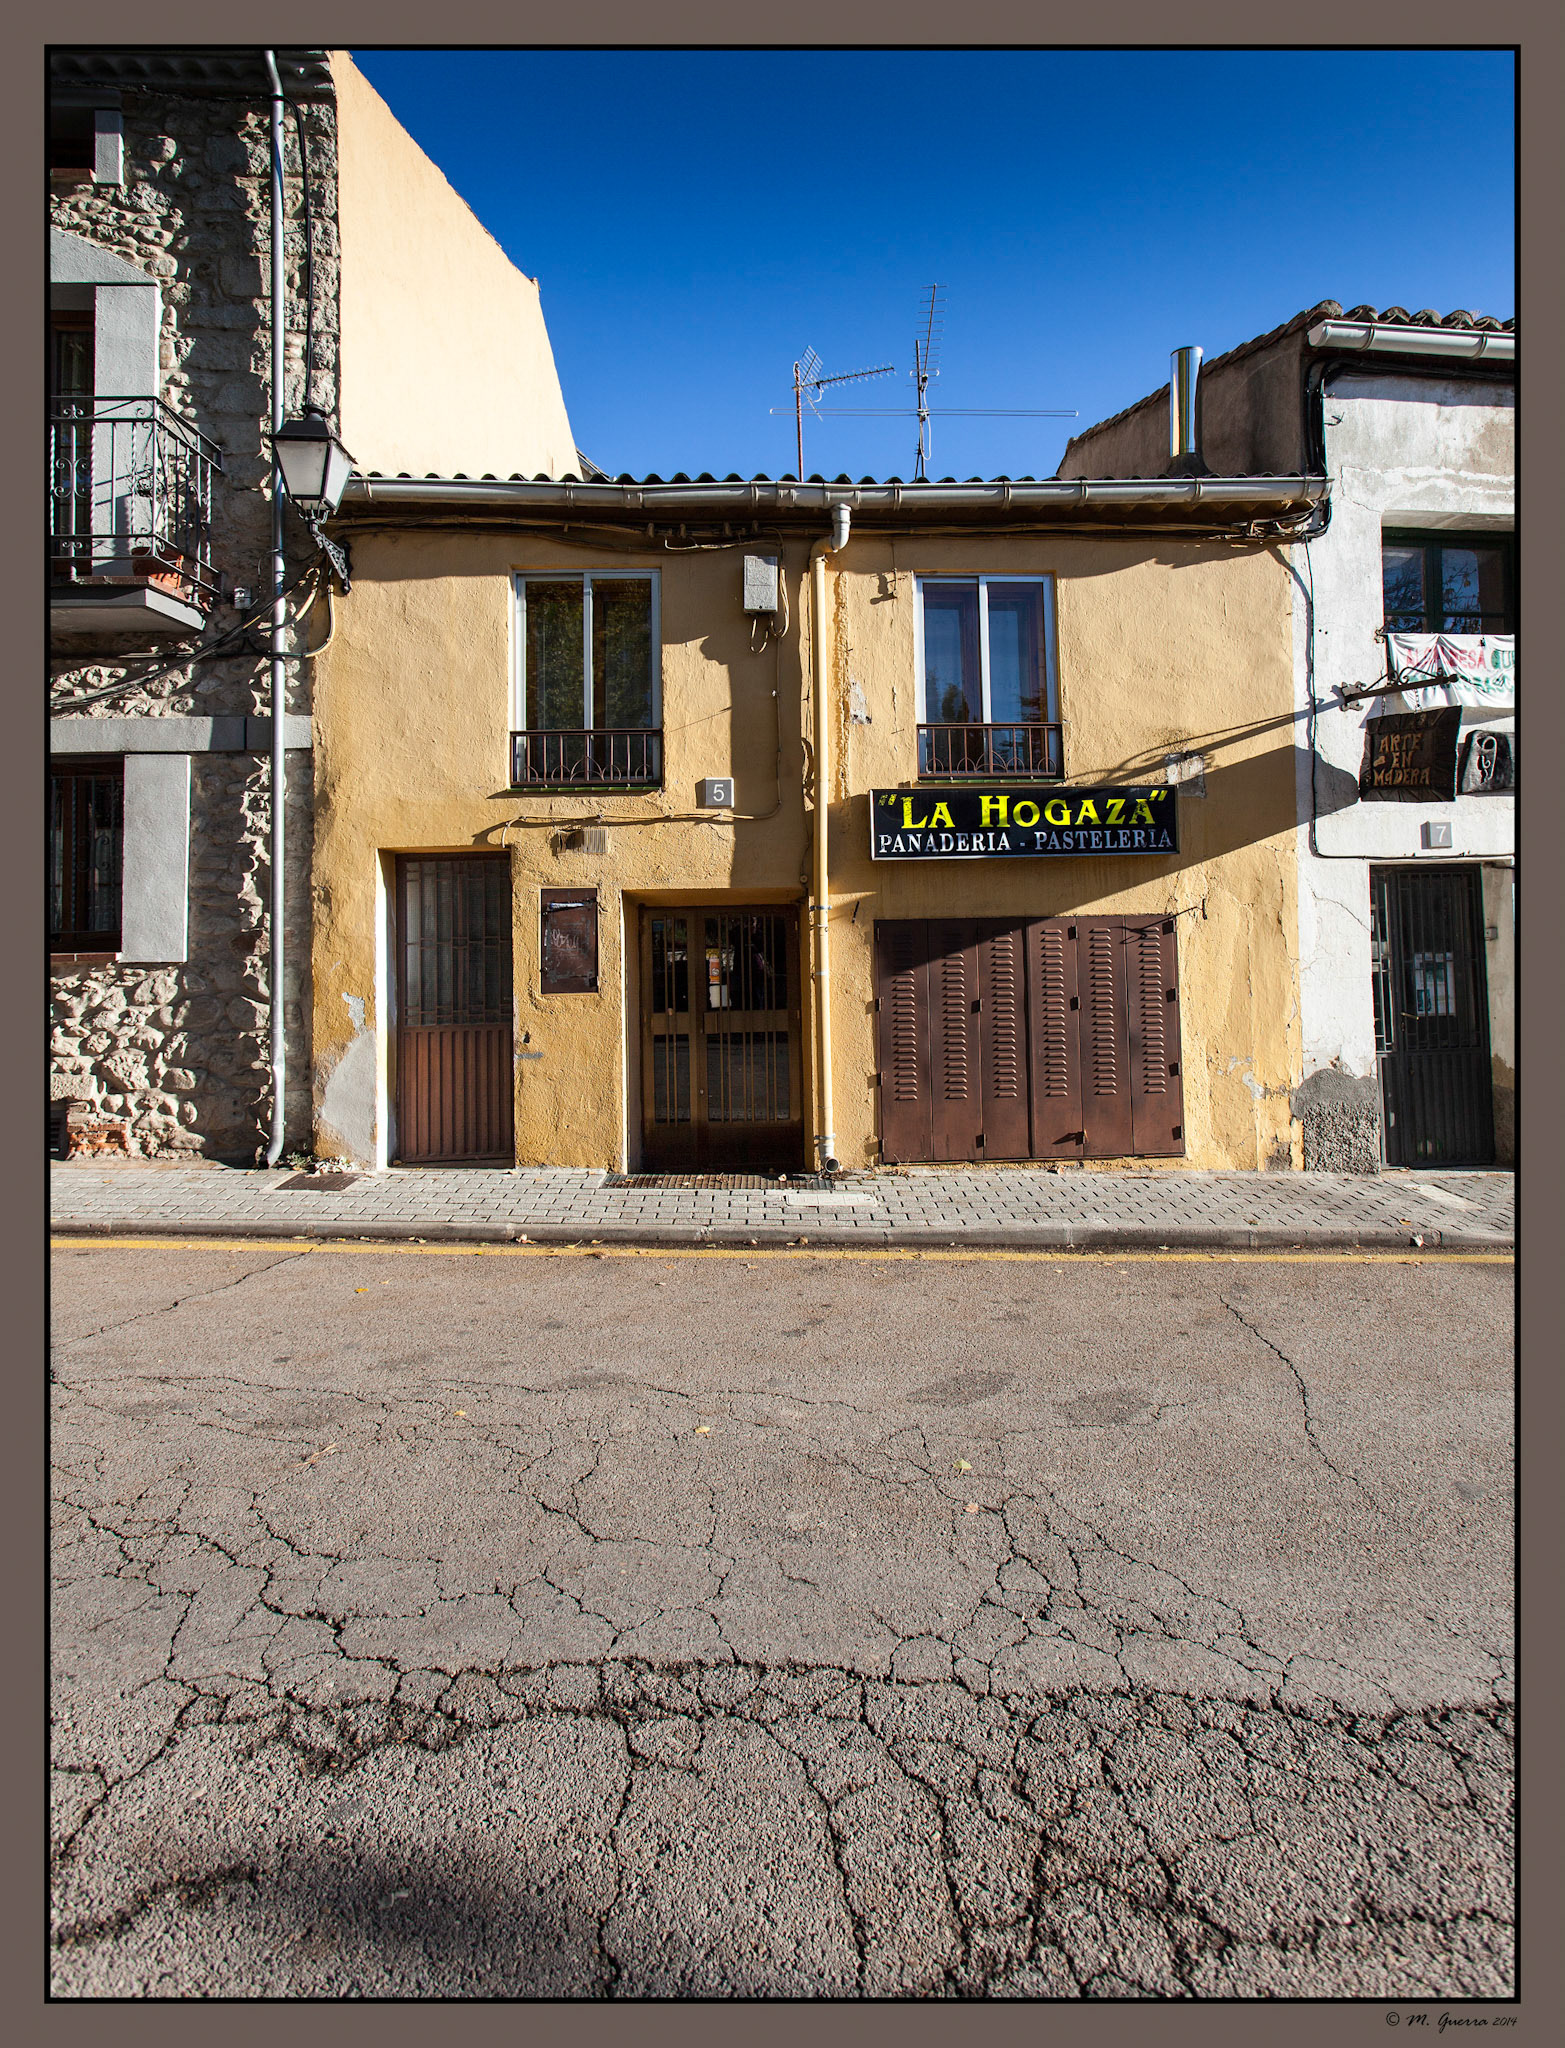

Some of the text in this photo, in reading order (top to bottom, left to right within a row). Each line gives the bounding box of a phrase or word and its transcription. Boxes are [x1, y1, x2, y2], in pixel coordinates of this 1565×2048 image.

[1379, 733, 1422, 752] ARTE
[1391, 751, 1414, 768] EN
[1373, 767, 1431, 786] MADERA
[713, 784, 725, 802] 5
[879, 832, 1012, 853] PANADERIA
[1034, 828, 1173, 850] PASTELERIA
[1436, 825, 1447, 843] 7
